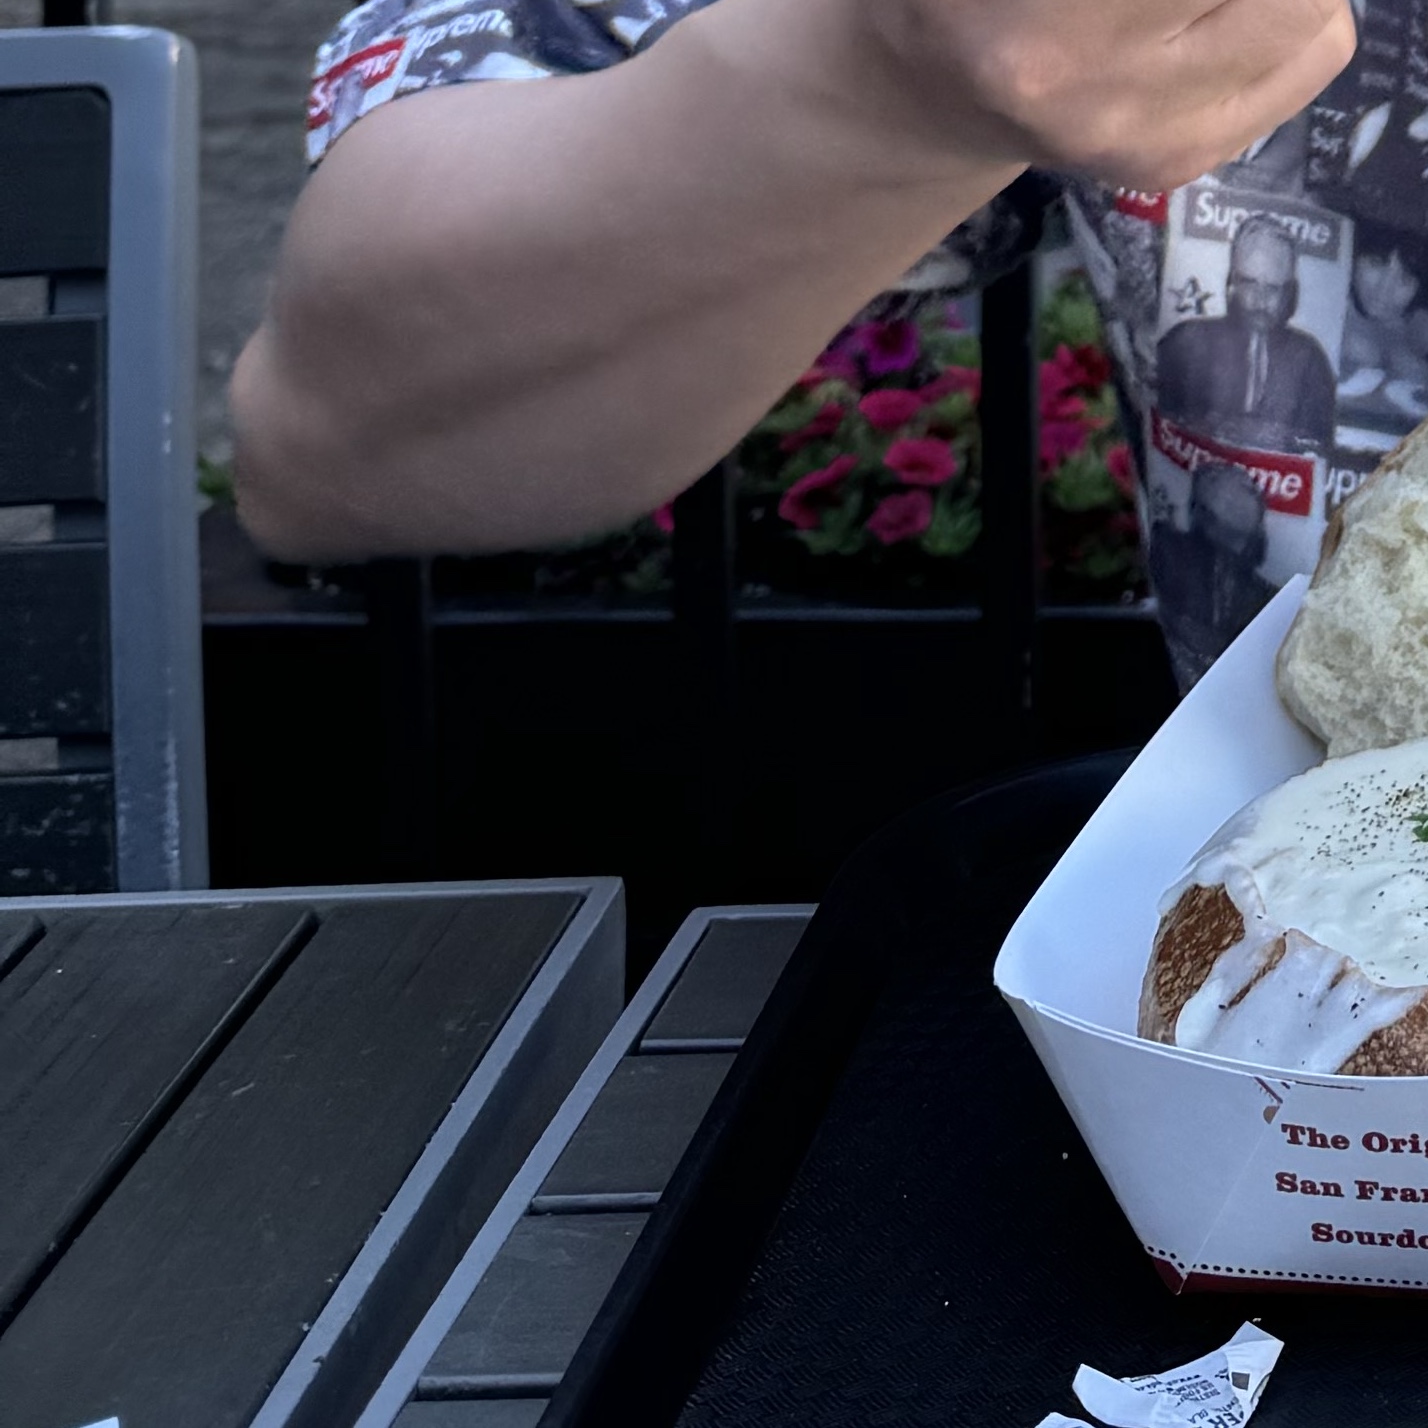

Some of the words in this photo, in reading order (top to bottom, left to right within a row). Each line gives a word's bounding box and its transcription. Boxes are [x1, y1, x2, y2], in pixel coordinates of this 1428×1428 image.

[1195, 191, 1331, 246] Supme
[1159, 416, 1302, 500] Supme
[1281, 1123, 1350, 1150] The
[1275, 1171, 1344, 1198] San
